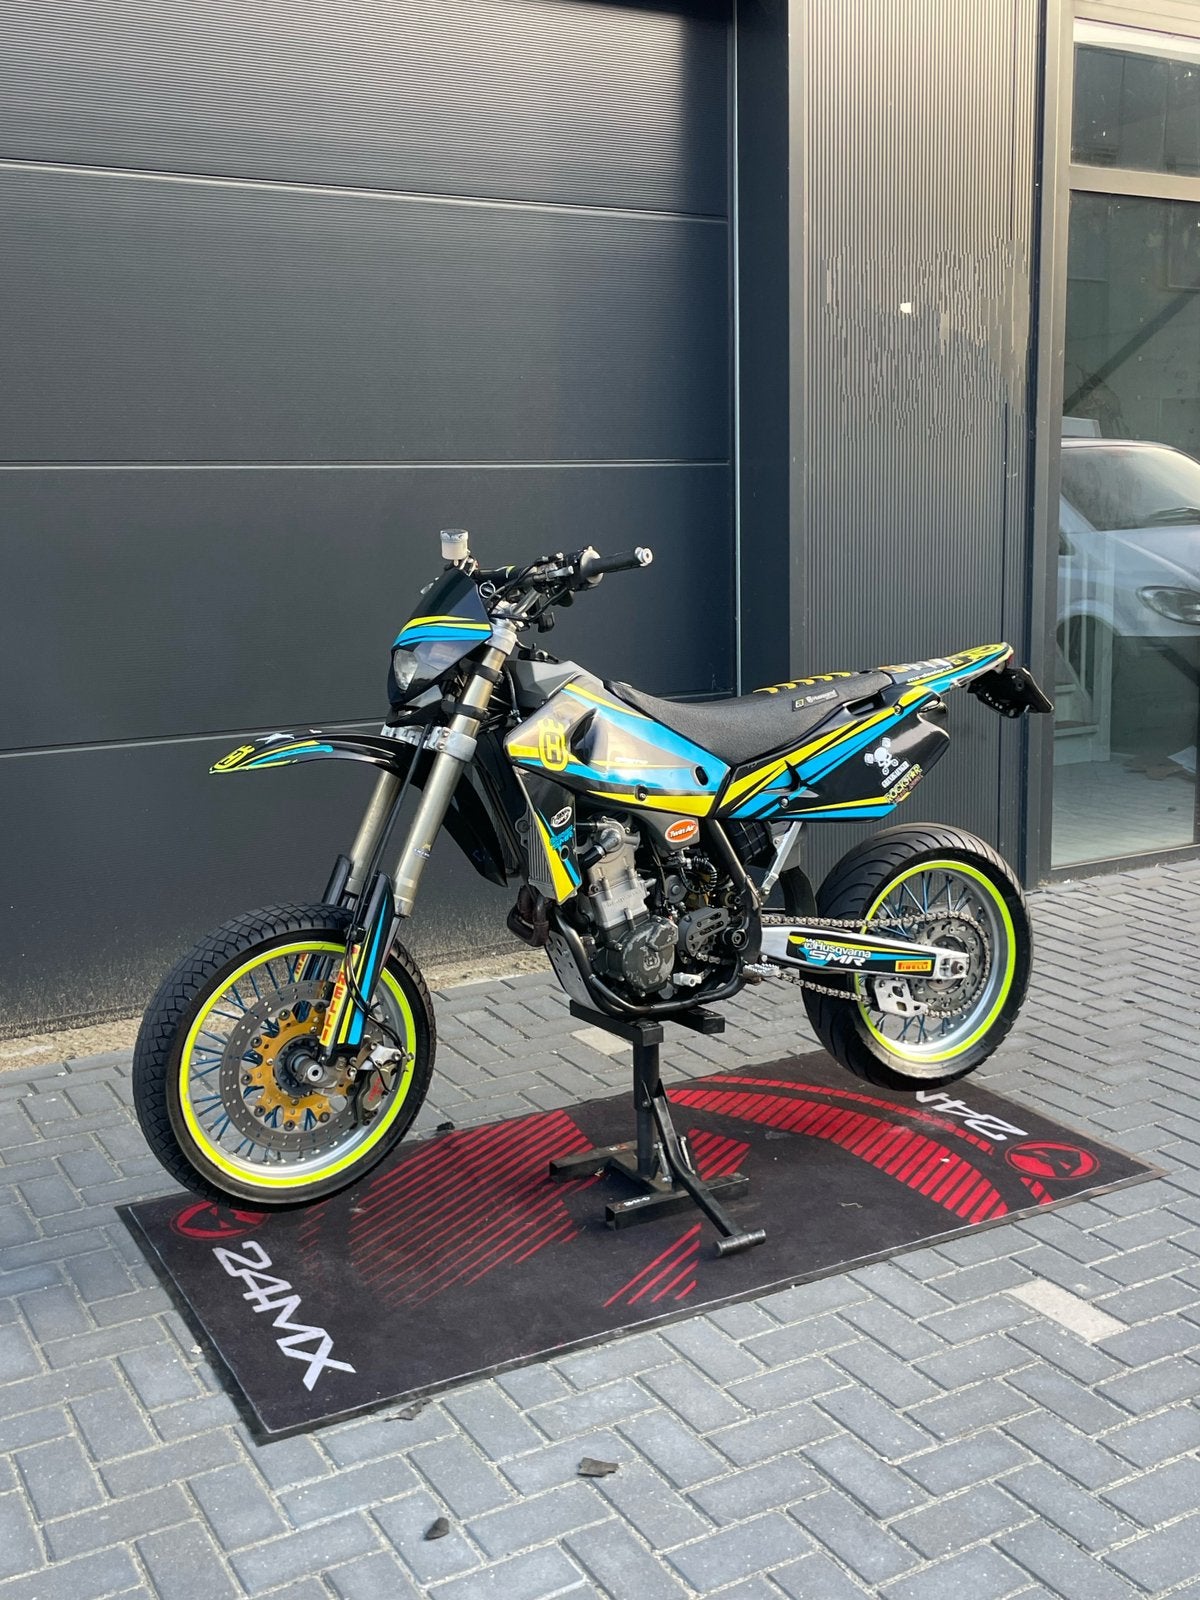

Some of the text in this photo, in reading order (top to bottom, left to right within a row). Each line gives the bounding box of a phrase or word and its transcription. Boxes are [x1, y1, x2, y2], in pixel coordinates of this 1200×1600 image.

[670, 824, 696, 838] Twin Air
[814, 941, 872, 958] Husqvarna
[808, 950, 866, 967] SMR
[212, 1240, 357, 1392] 24MX
